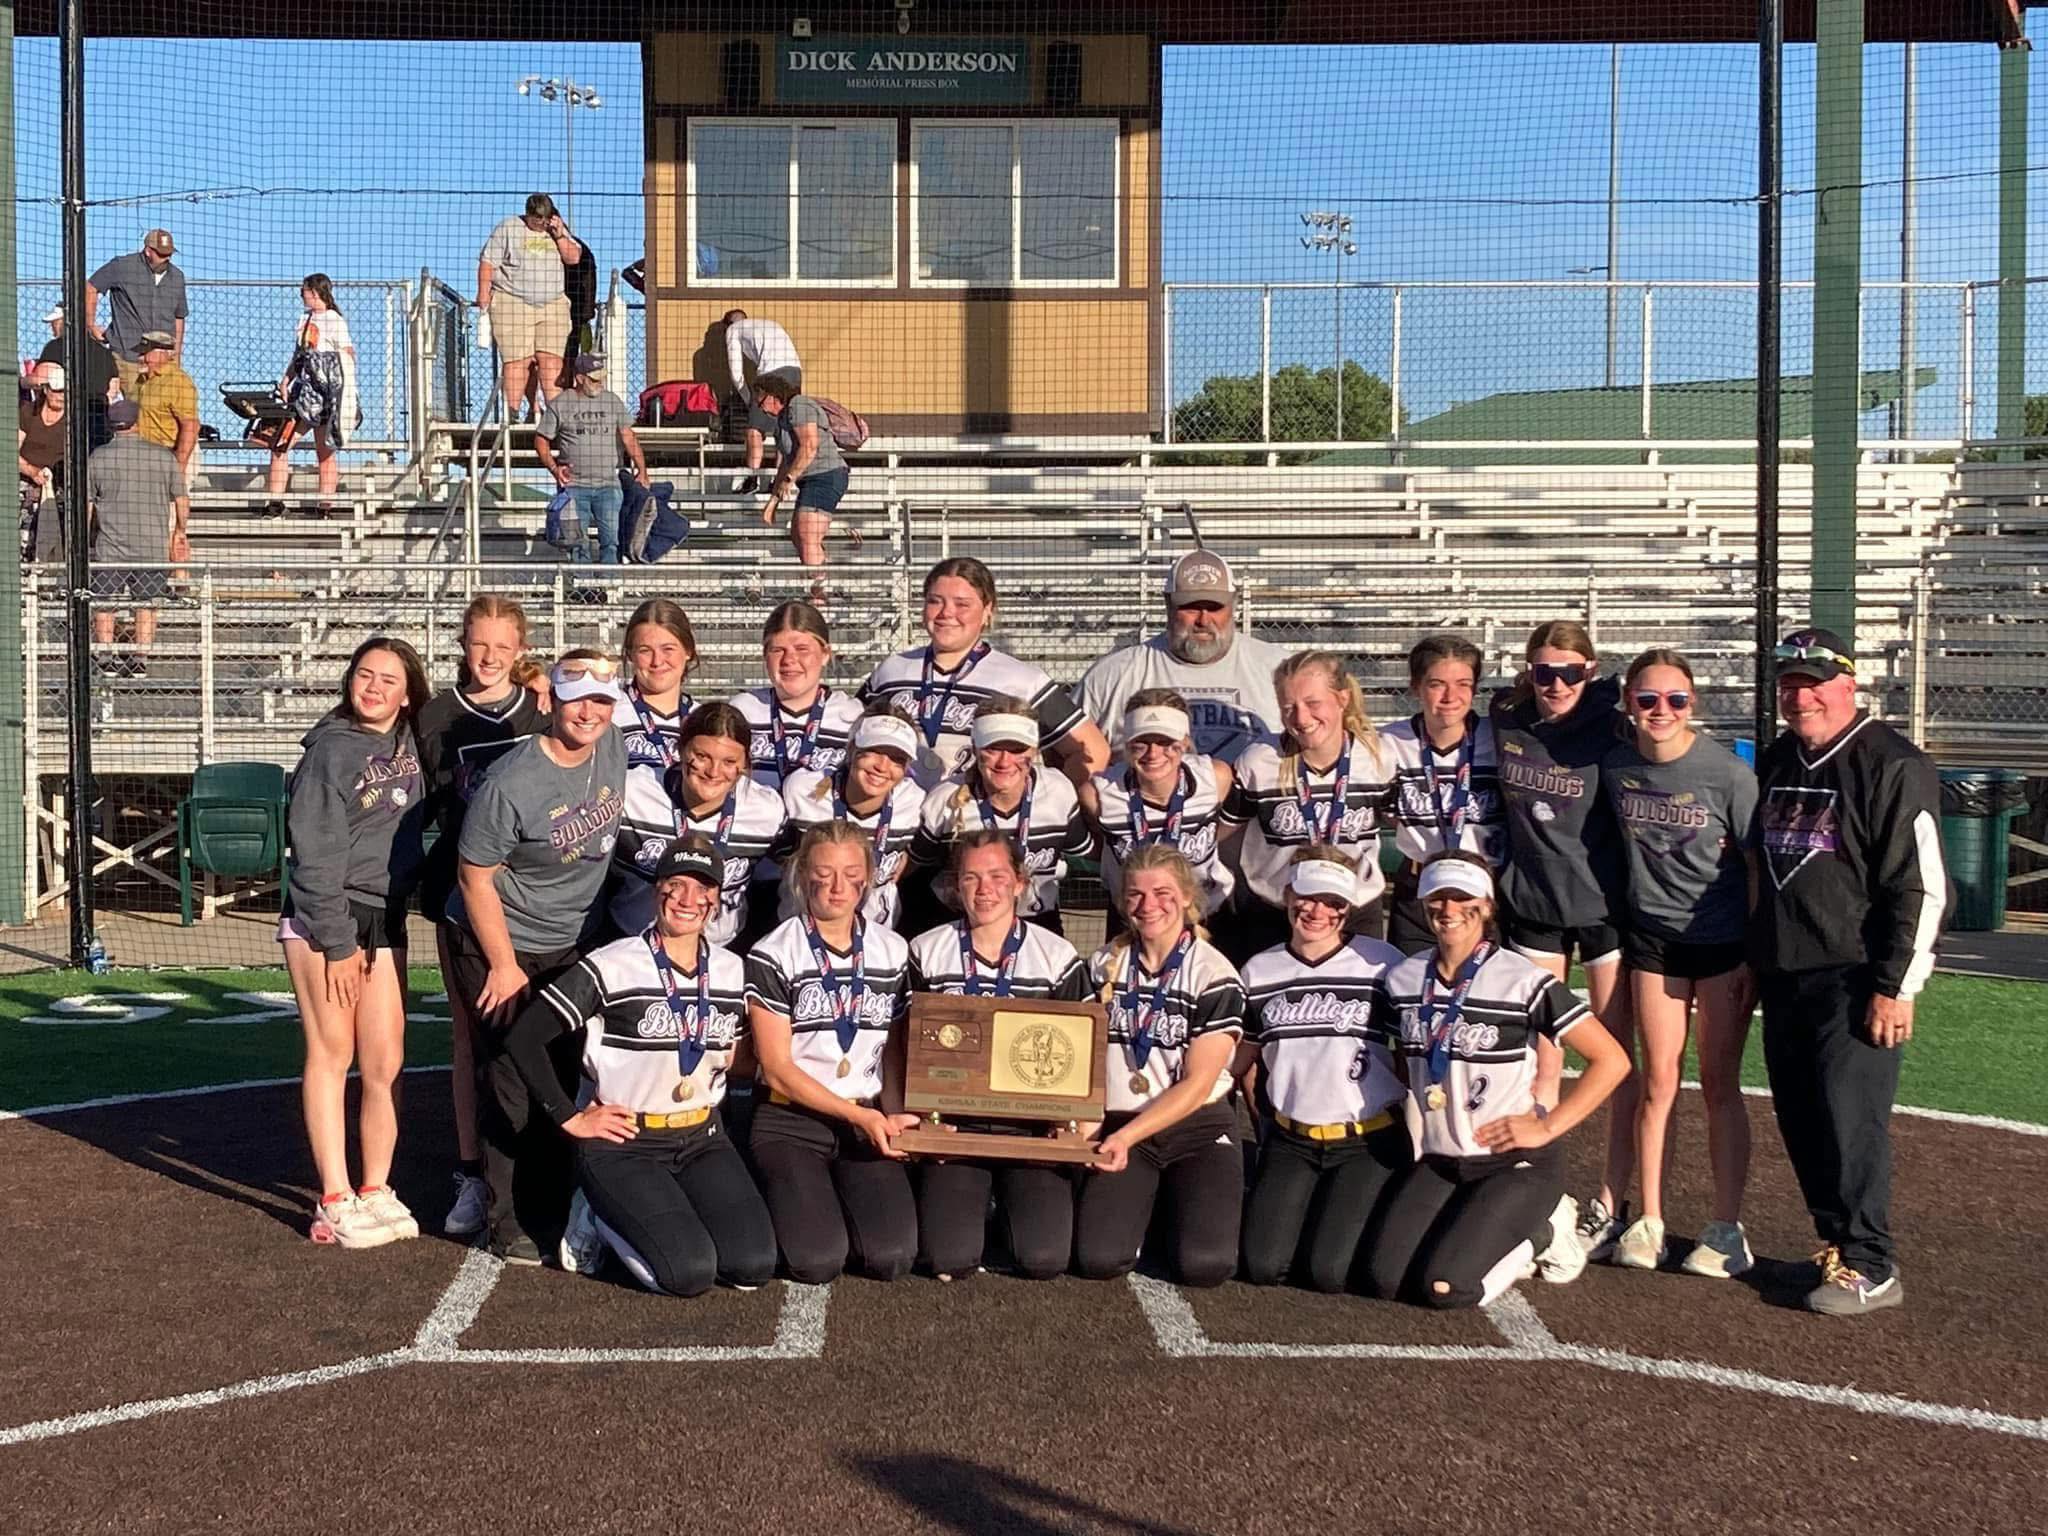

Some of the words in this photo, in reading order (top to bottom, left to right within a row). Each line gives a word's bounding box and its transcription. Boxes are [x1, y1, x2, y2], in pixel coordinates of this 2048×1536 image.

[788, 51, 856, 71] DICK
[866, 51, 1018, 73] ANDERSON
[846, 79, 902, 88] MEMORIAL
[905, 79, 936, 88] PRESS
[938, 79, 960, 89] BOX
[1261, 991, 1371, 1033] Bulldogs
[1464, 1073, 1490, 1111] 2
[980, 1099, 1009, 1110] STATE
[1015, 1101, 1072, 1113] CHAMPIONS
